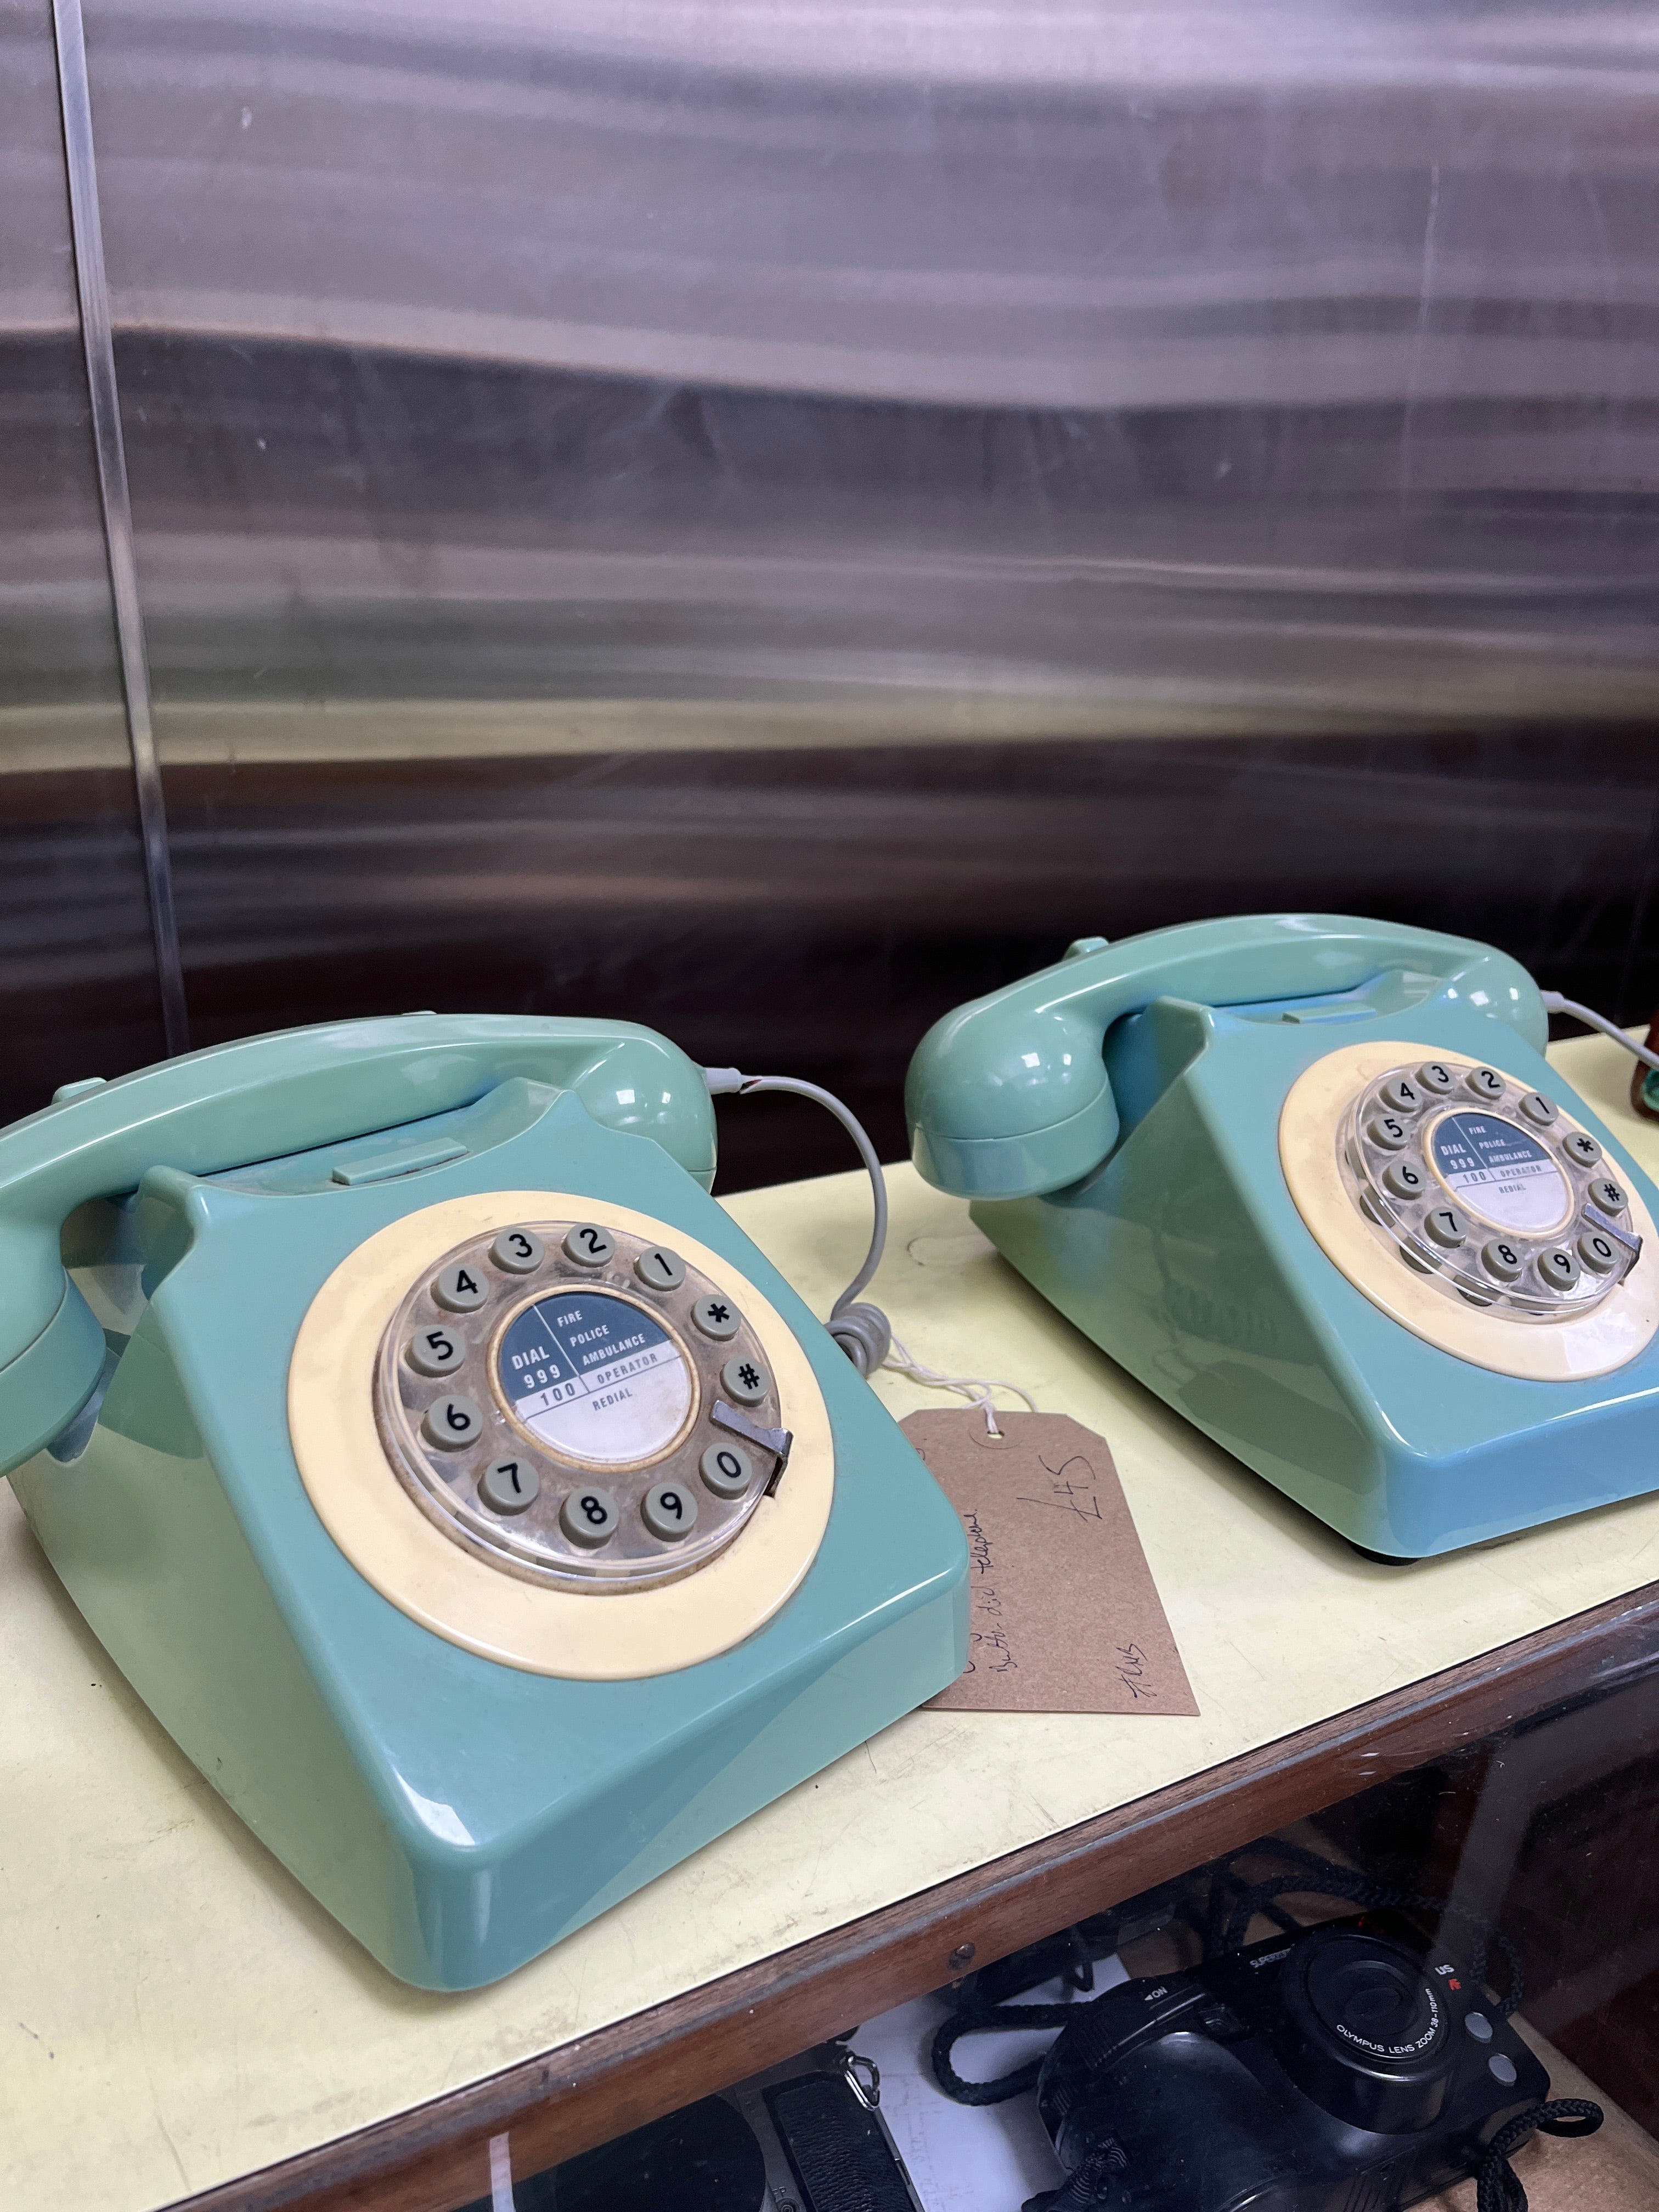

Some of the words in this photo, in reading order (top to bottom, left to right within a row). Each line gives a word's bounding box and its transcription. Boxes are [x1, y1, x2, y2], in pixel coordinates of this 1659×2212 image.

[1432, 1066, 1448, 1082] 3
[1482, 1071, 1500, 1088] 2
[1401, 1083, 1415, 1099] 4
[1536, 1097, 1549, 1113] 1
[1384, 1119, 1402, 1137] 5
[1468, 1126, 1487, 1135] FIRE
[1440, 1143, 1466, 1155] DIAL
[1479, 1139, 1506, 1149] POLICE
[1450, 1157, 1475, 1170] 999
[1488, 1150, 1532, 1164] AMBULANCE
[1403, 1166, 1418, 1184] 6
[1463, 1171, 1487, 1183] 100
[1500, 1165, 1542, 1177] OPERATOR
[1499, 1183, 1526, 1194] REDIAL
[1440, 1212, 1457, 1231] 7
[509, 1234, 532, 1257] 3
[580, 1229, 606, 1253] 2
[1593, 1238, 1611, 1257] 0
[1498, 1245, 1517, 1264] 8
[1554, 1255, 1570, 1273] 9
[654, 1254, 672, 1276] 1
[457, 1270, 478, 1294] 4
[557, 1311, 582, 1327] FIRE
[427, 1331, 453, 1360] 5
[569, 1324, 610, 1347] POLICE
[512, 1346, 550, 1370] DIAL
[583, 1333, 646, 1366] AMBULANCE
[523, 1364, 561, 1389] 999
[597, 1353, 658, 1384] OPERATOR
[540, 1383, 575, 1406] 100
[592, 1387, 633, 1411] REDIAL
[447, 1404, 470, 1430] 6
[717, 1452, 741, 1478] 0
[498, 1463, 521, 1493] 7
[1017, 1455, 1103, 1523] £45
[581, 1497, 607, 1524] 8
[660, 1492, 682, 1519] 9
[1336, 2024, 1385, 2052] OLYMPUS
[1388, 2044, 1415, 2053] LENS
[1415, 2027, 1436, 2049] ZOOM
